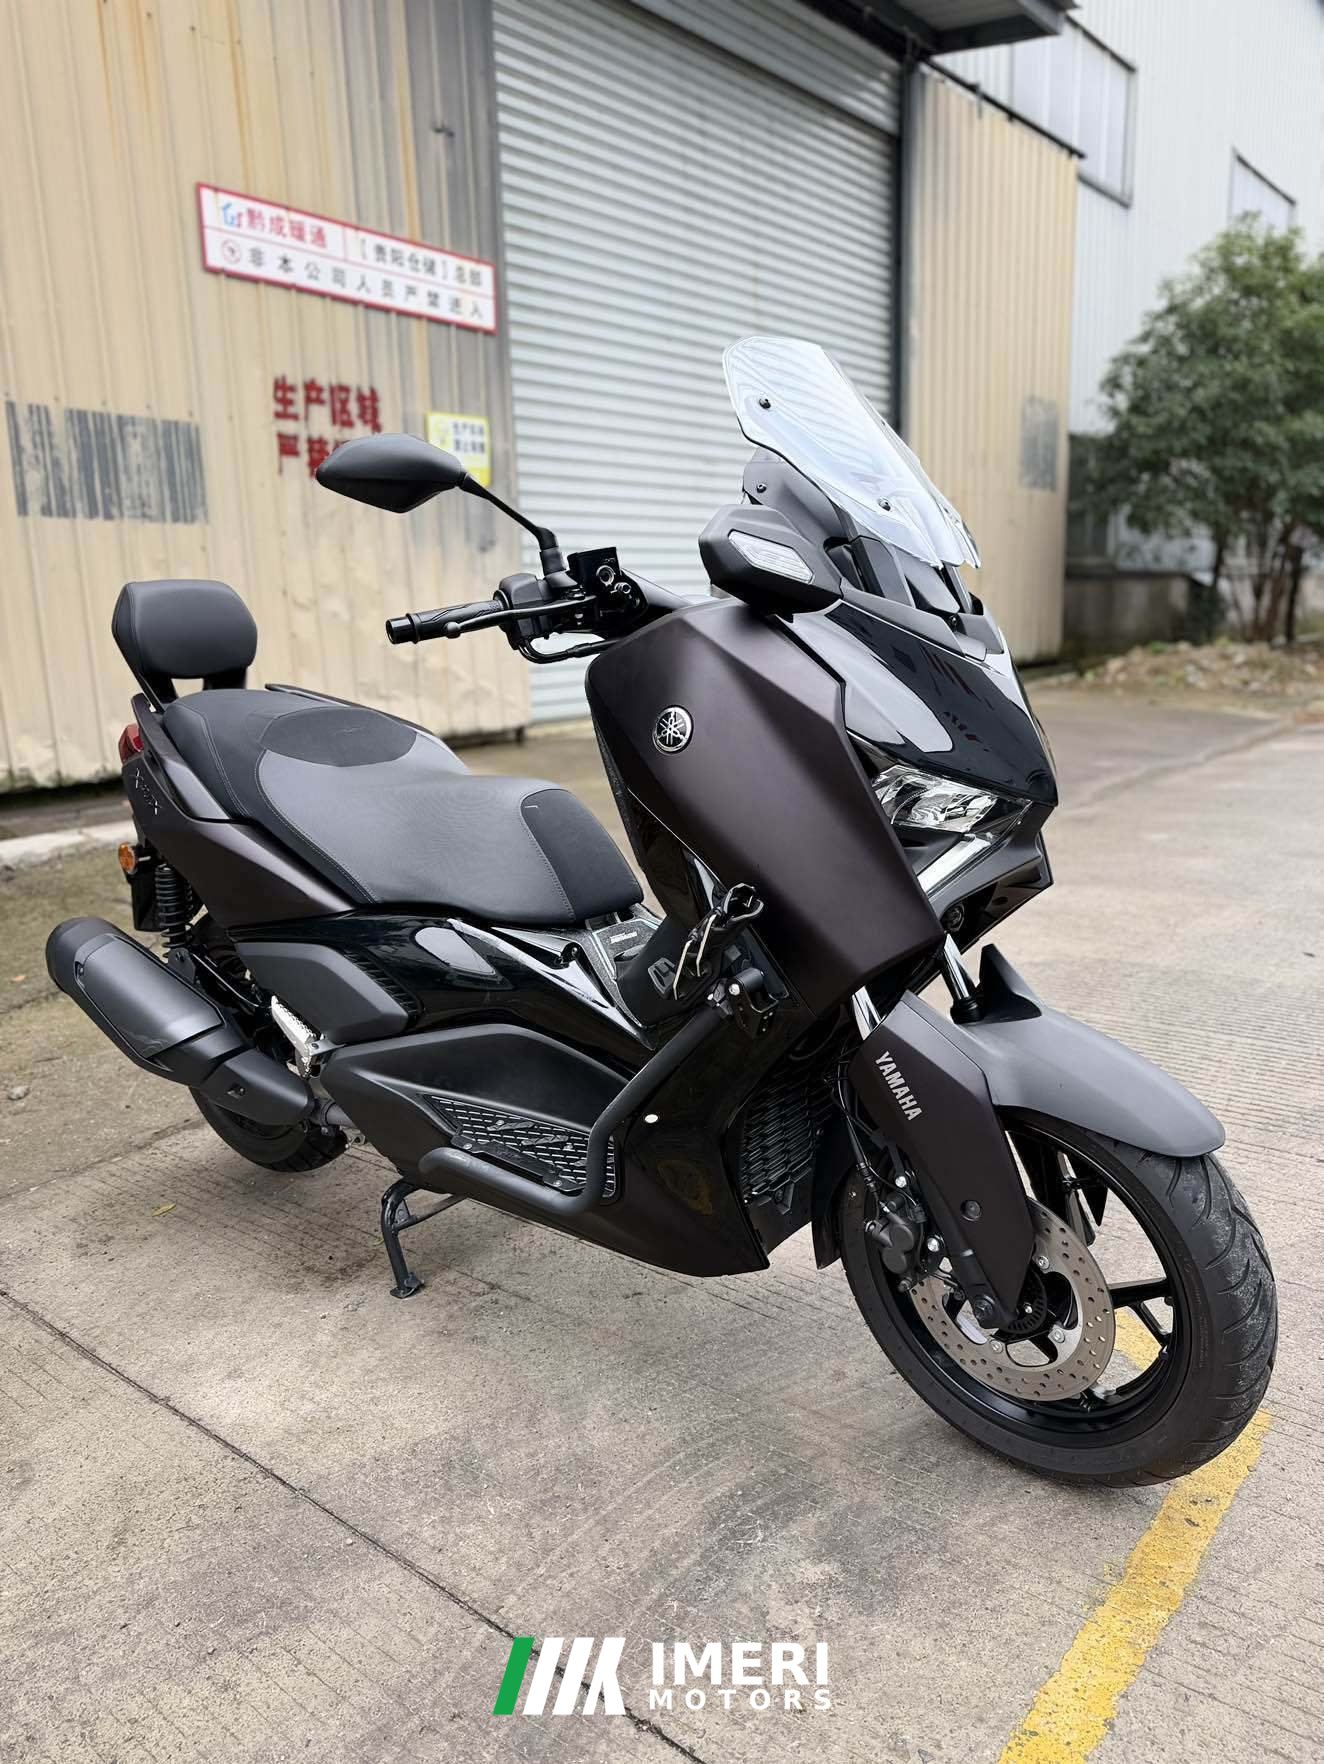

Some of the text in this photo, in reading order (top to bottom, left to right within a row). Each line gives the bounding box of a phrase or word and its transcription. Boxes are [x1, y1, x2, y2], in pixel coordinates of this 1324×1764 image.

[273, 374, 382, 433] 生产区域
[276, 431, 341, 478] 严禁
[875, 1050, 923, 1121] YAMAHA
